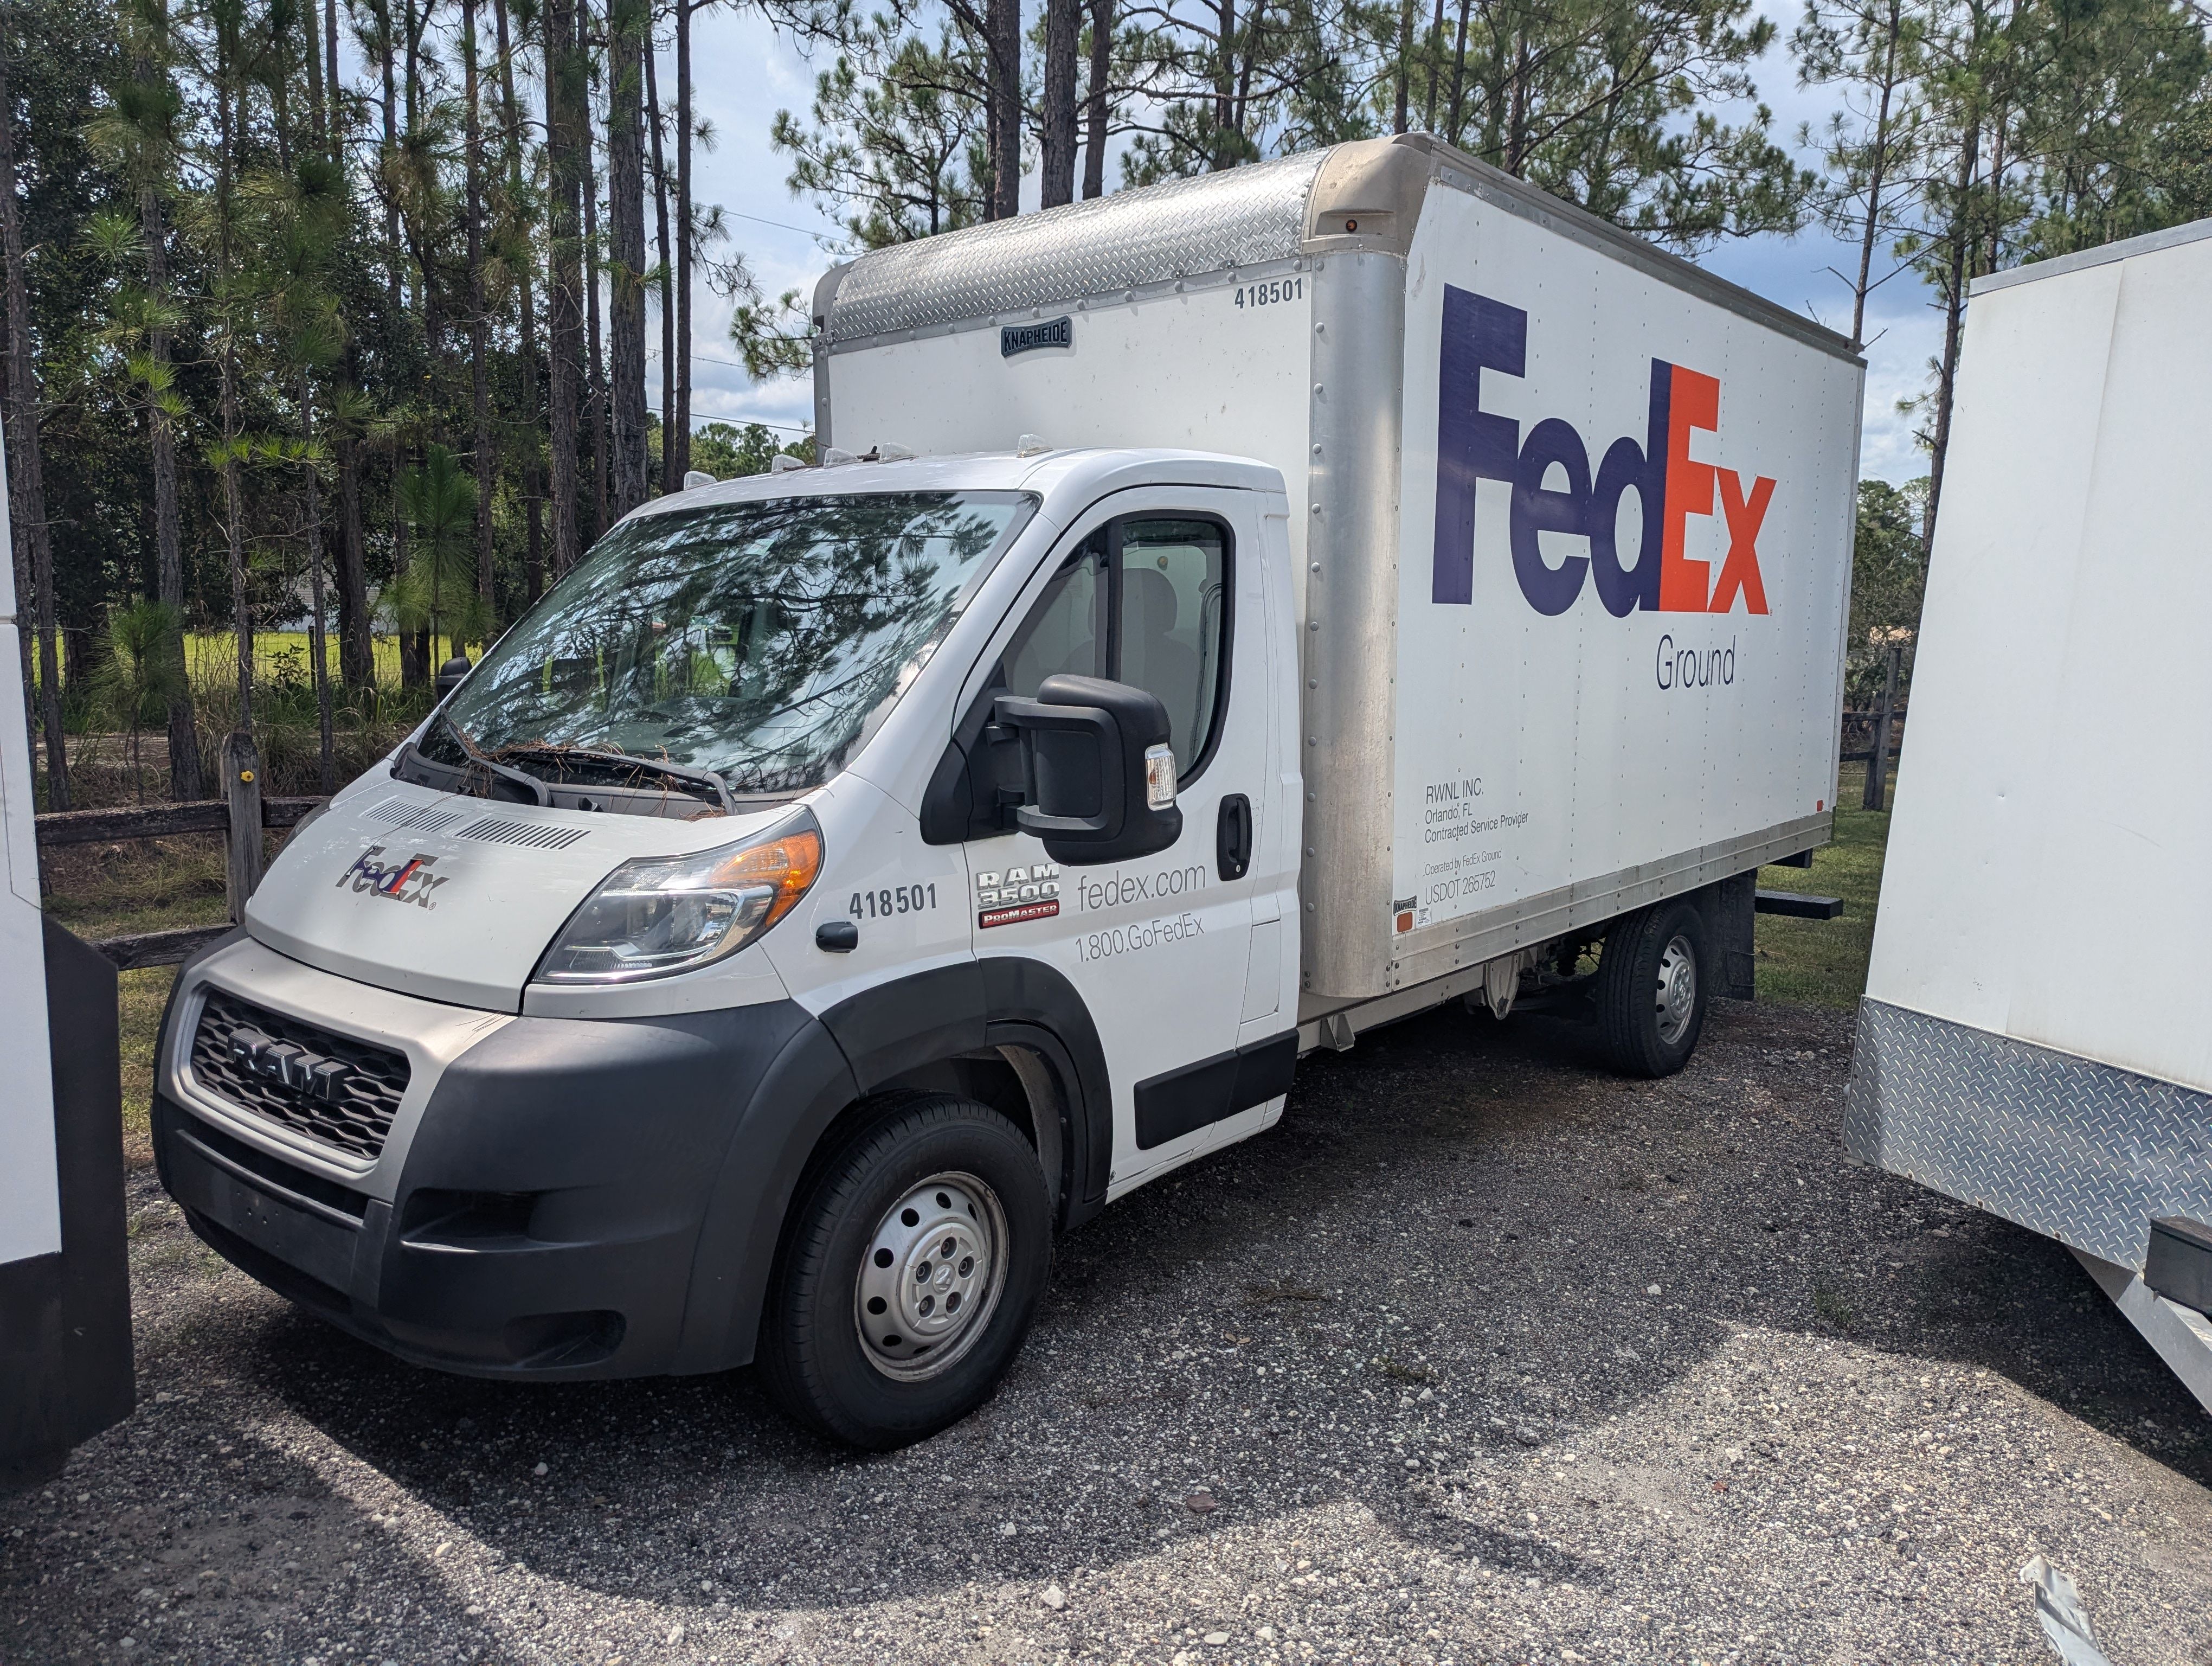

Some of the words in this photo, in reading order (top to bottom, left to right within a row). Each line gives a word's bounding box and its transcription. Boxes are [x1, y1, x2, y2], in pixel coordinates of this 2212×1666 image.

[1234, 278, 1303, 309] 418501
[1004, 319, 1068, 352] KNAPHEIDE
[1432, 283, 1777, 618] FedEx
[1656, 634, 1736, 690] Ground
[1426, 781, 1459, 804] RWNL
[1462, 778, 1484, 798] INC.
[1425, 805, 1461, 824] Orlando,
[1463, 802, 1473, 817] FL
[1425, 822, 1469, 843] Contracted
[1471, 817, 1499, 834] Service
[1500, 811, 1529, 828] Provider
[977, 863, 1059, 890] RAM
[1425, 858, 1454, 877] Operated
[1455, 857, 1462, 870] by
[1463, 853, 1481, 867] FedEx
[1482, 848, 1502, 862] Ground
[849, 883, 937, 920] 418501
[978, 881, 1060, 909] 3500
[1077, 864, 1206, 912] fedex.com
[1425, 879, 1461, 905] USDOT
[1462, 870, 1496, 895] 265752
[1075, 913, 1205, 963] 1.800.GoFedEx
[226, 1029, 343, 1101] RAM
